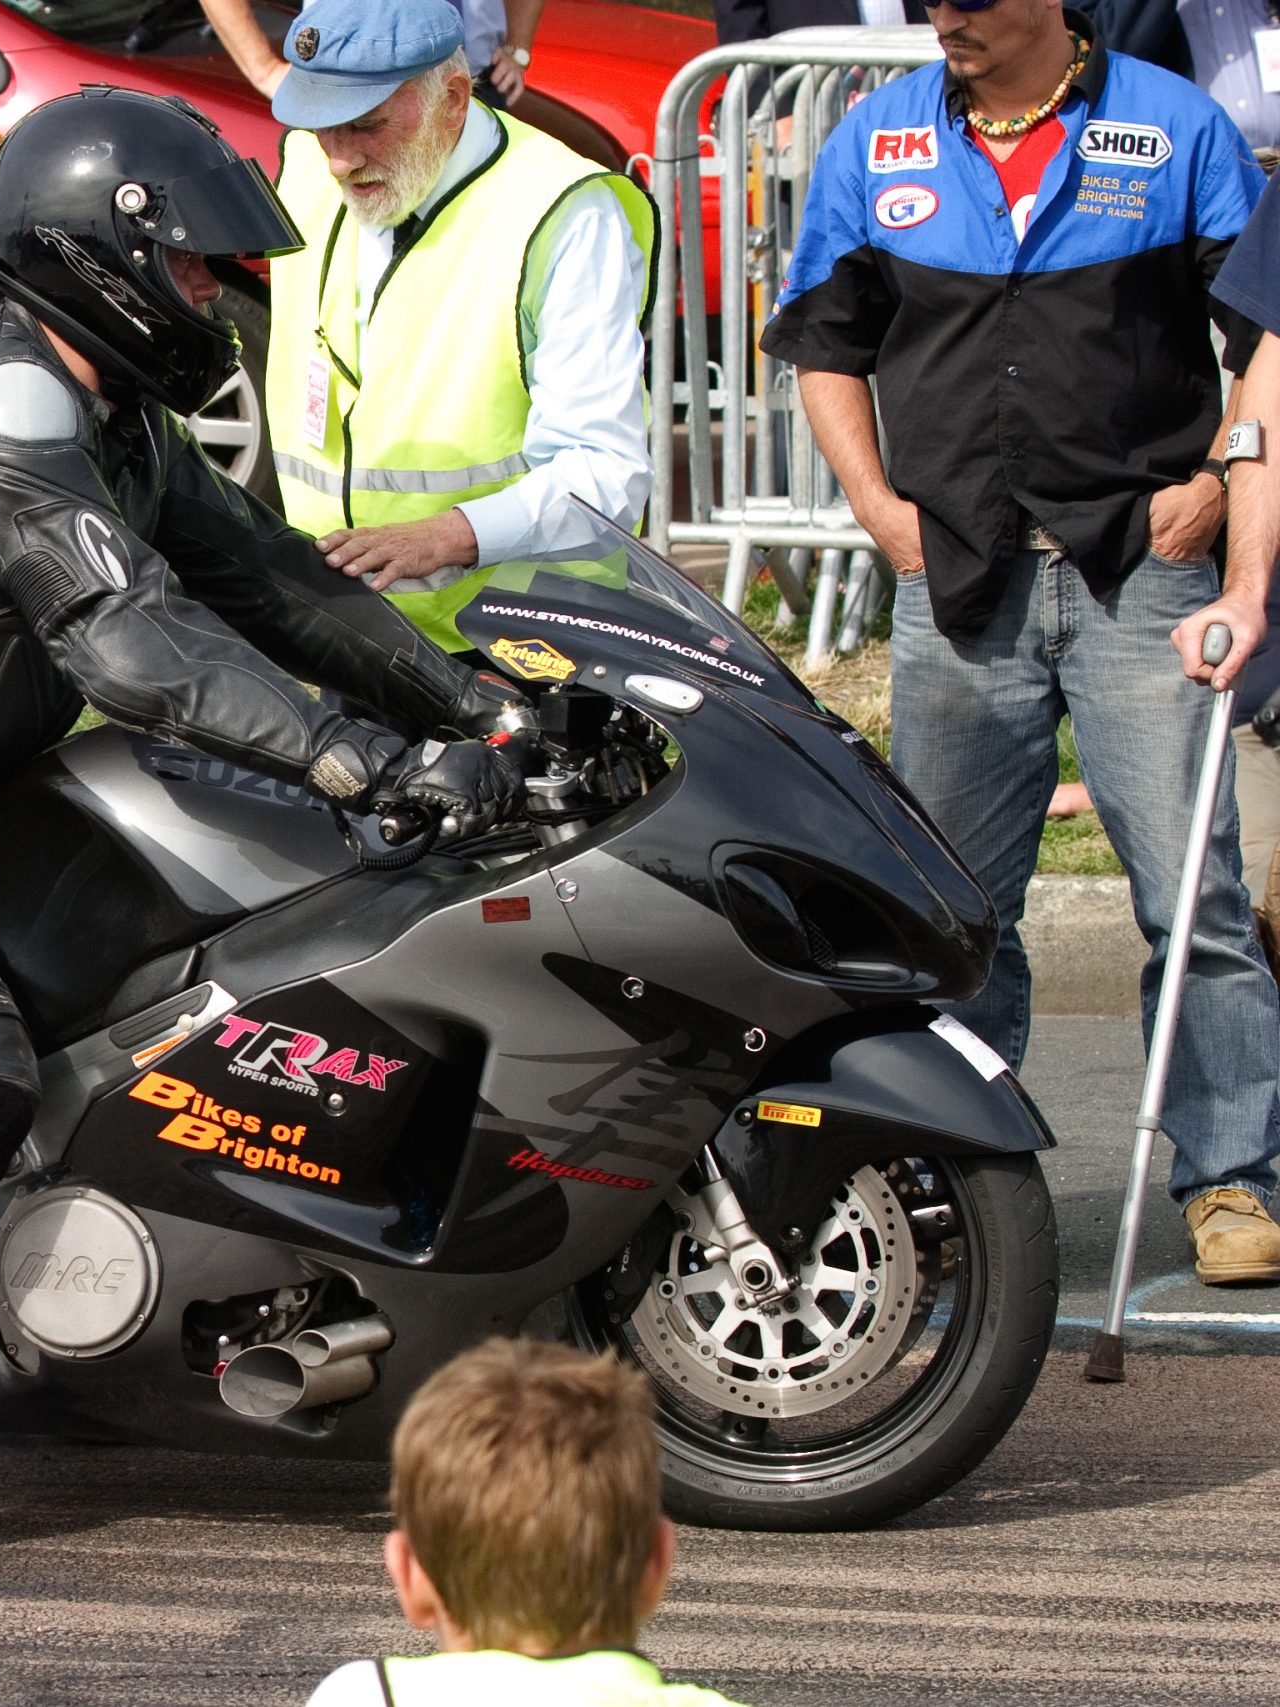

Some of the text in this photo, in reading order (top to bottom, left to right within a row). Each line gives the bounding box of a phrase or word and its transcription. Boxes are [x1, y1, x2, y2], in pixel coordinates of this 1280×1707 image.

[873, 131, 932, 161] RK
[1086, 130, 1158, 158] SHOEI
[1077, 189, 1146, 208] BRIGHTON
[1081, 174, 1148, 193] BIKES OF
[1074, 203, 1144, 220] DRAG RACING
[491, 638, 574, 671] Putoline
[156, 756, 325, 812] SUZU
[214, 1014, 409, 1092] TRAX
[227, 1063, 320, 1098] HYPER SPORTS
[127, 1071, 308, 1147] Bikes of
[762, 1104, 816, 1123] PIRELLI
[157, 1112, 342, 1185] Brighton
[505, 1148, 659, 1191] Hayabusa
